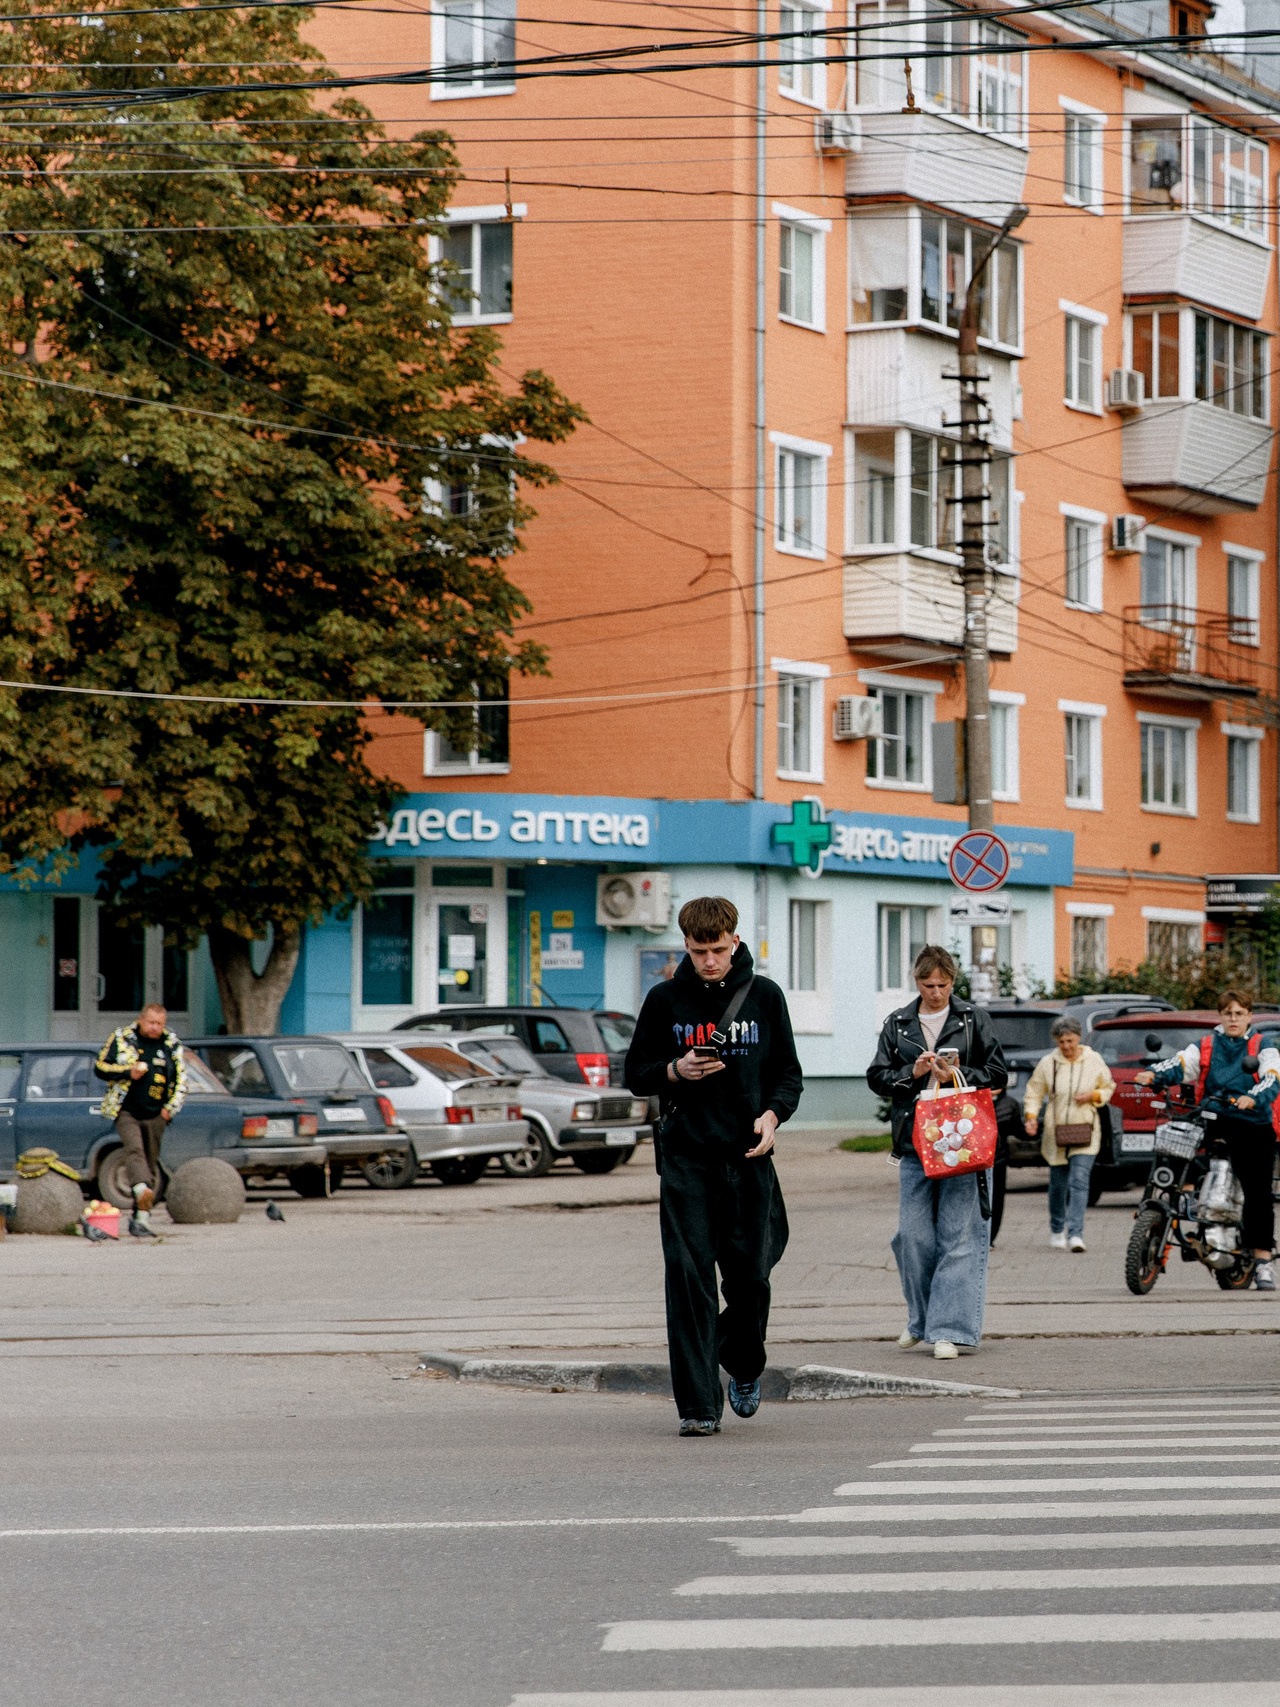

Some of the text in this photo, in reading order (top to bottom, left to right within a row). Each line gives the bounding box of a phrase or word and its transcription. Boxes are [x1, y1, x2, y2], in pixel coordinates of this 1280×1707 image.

[508, 809, 650, 847] аптека
[833, 825, 958, 864] здесь апте
[672, 1020, 759, 1046] TRAPTAR
